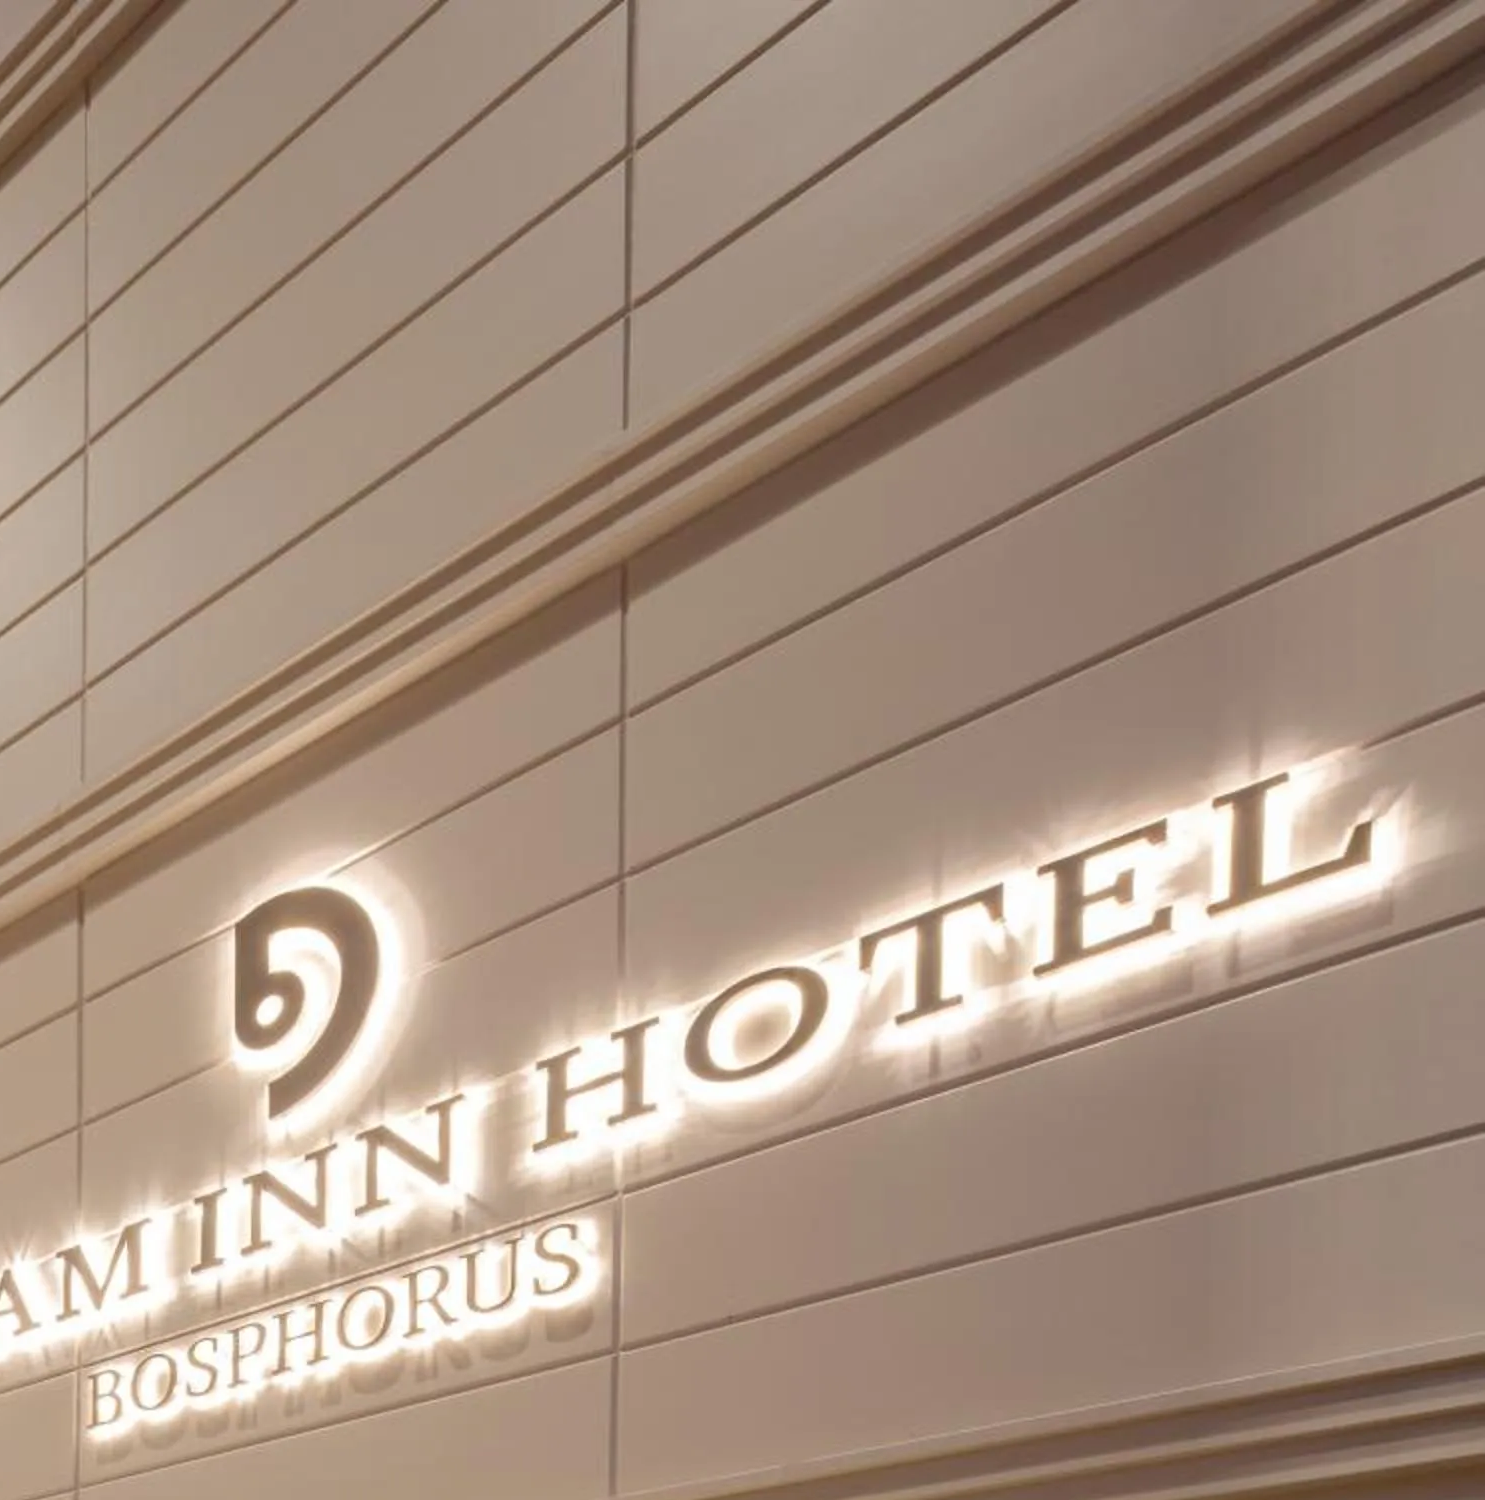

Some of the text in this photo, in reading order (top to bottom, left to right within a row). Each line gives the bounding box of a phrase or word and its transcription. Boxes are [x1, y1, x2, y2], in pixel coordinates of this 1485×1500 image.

[190, 1093, 465, 1274] INN
[531, 771, 1375, 1153] HOTEL
[85, 1222, 582, 1432] BOSPHORUS
